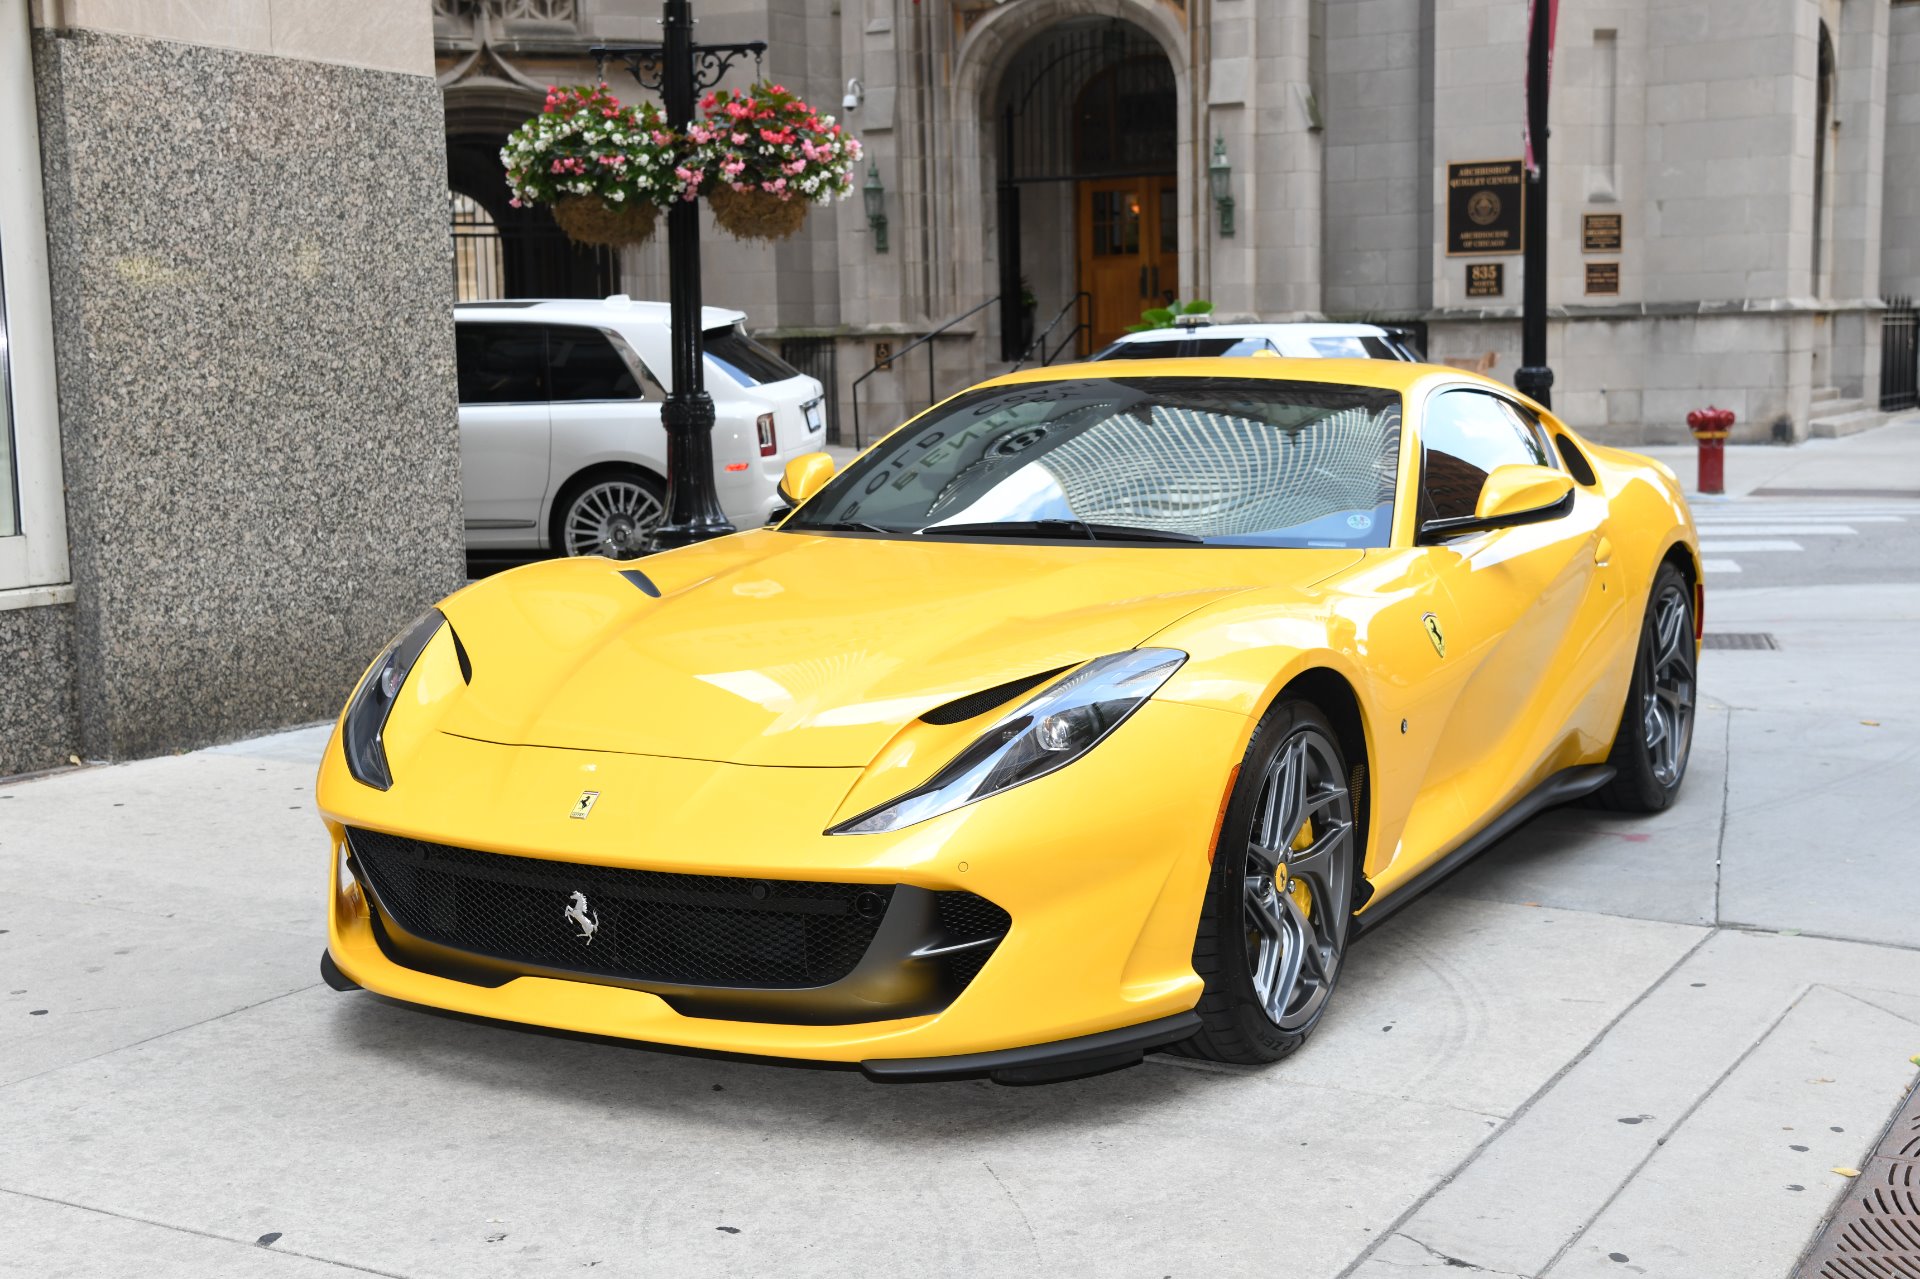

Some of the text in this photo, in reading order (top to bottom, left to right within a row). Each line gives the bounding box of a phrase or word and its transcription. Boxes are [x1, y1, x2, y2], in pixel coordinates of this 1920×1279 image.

[1459, 167, 1511, 176] ARCHBISHOP
[1486, 175, 1519, 185] CENTER
[1459, 230, 1509, 240] ARCHDIOCESE
[1473, 240, 1506, 248] CHICAGO
[1472, 265, 1497, 280] 835
